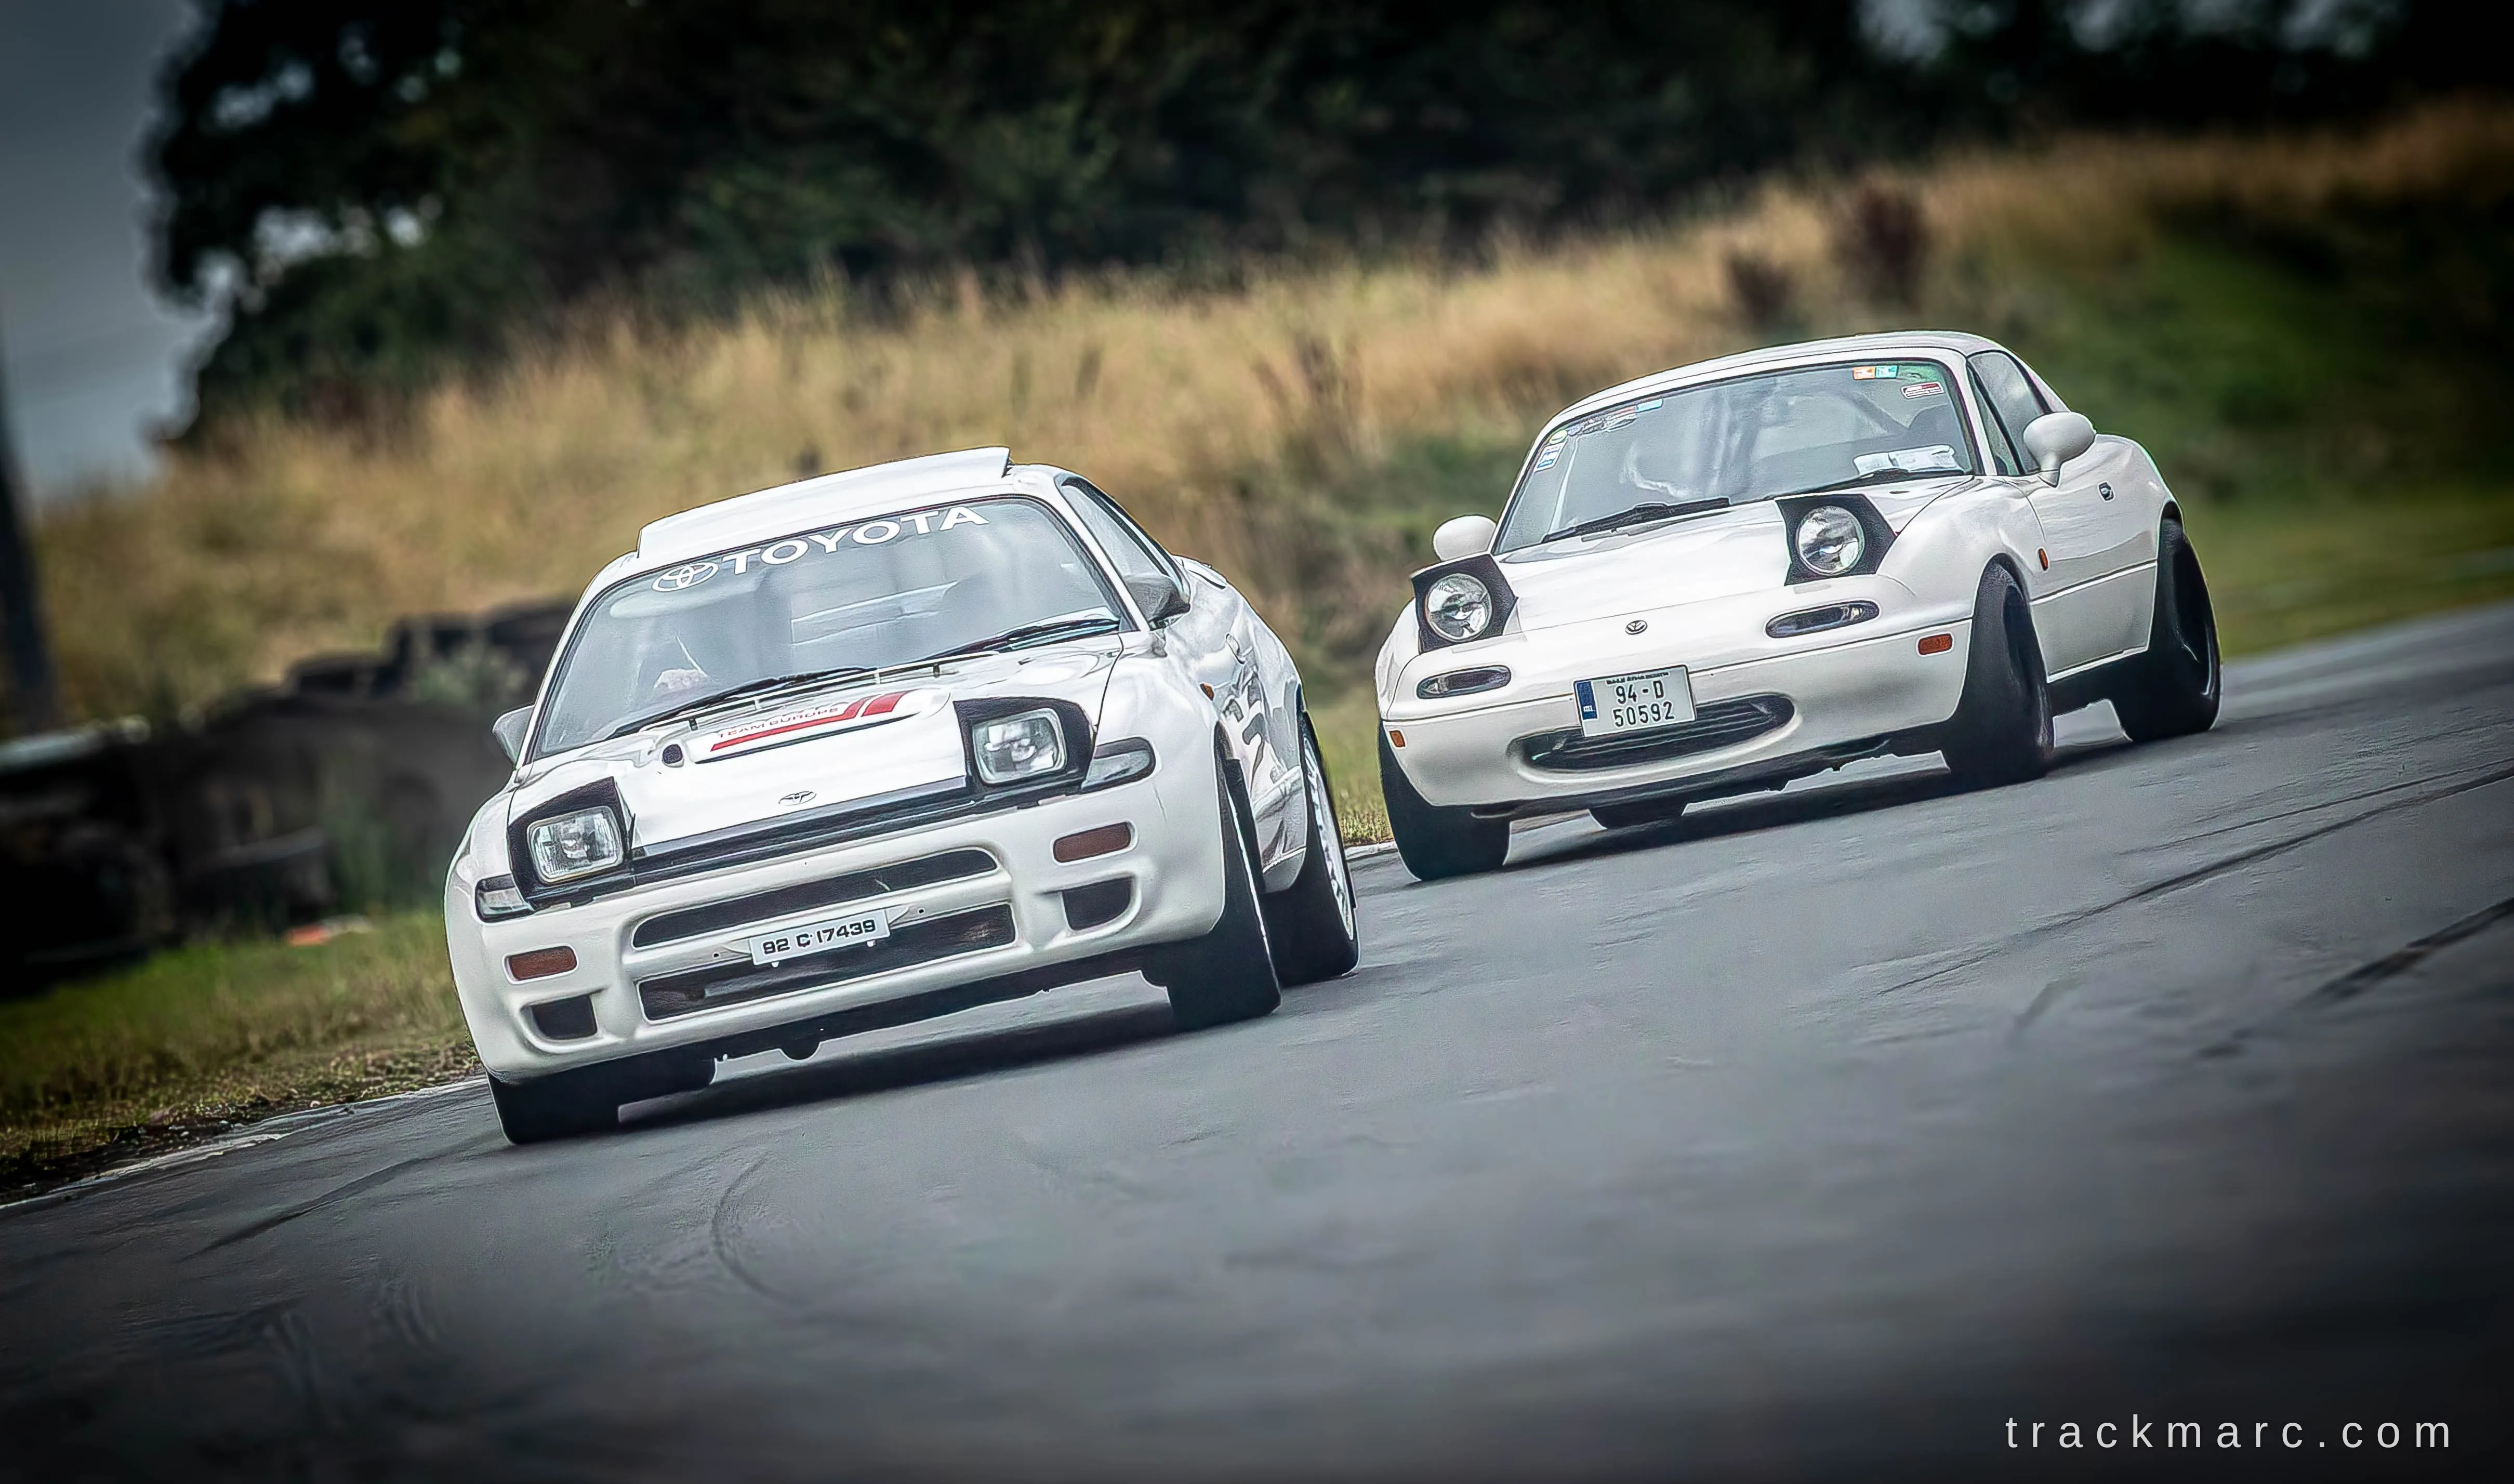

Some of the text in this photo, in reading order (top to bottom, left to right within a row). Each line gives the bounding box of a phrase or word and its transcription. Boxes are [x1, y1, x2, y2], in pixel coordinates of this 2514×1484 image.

[722, 506, 989, 575] TOYOTA
[1613, 701, 1675, 727] 50592
[718, 723, 765, 738] TEAM
[762, 919, 876, 955] 92 C 17439
